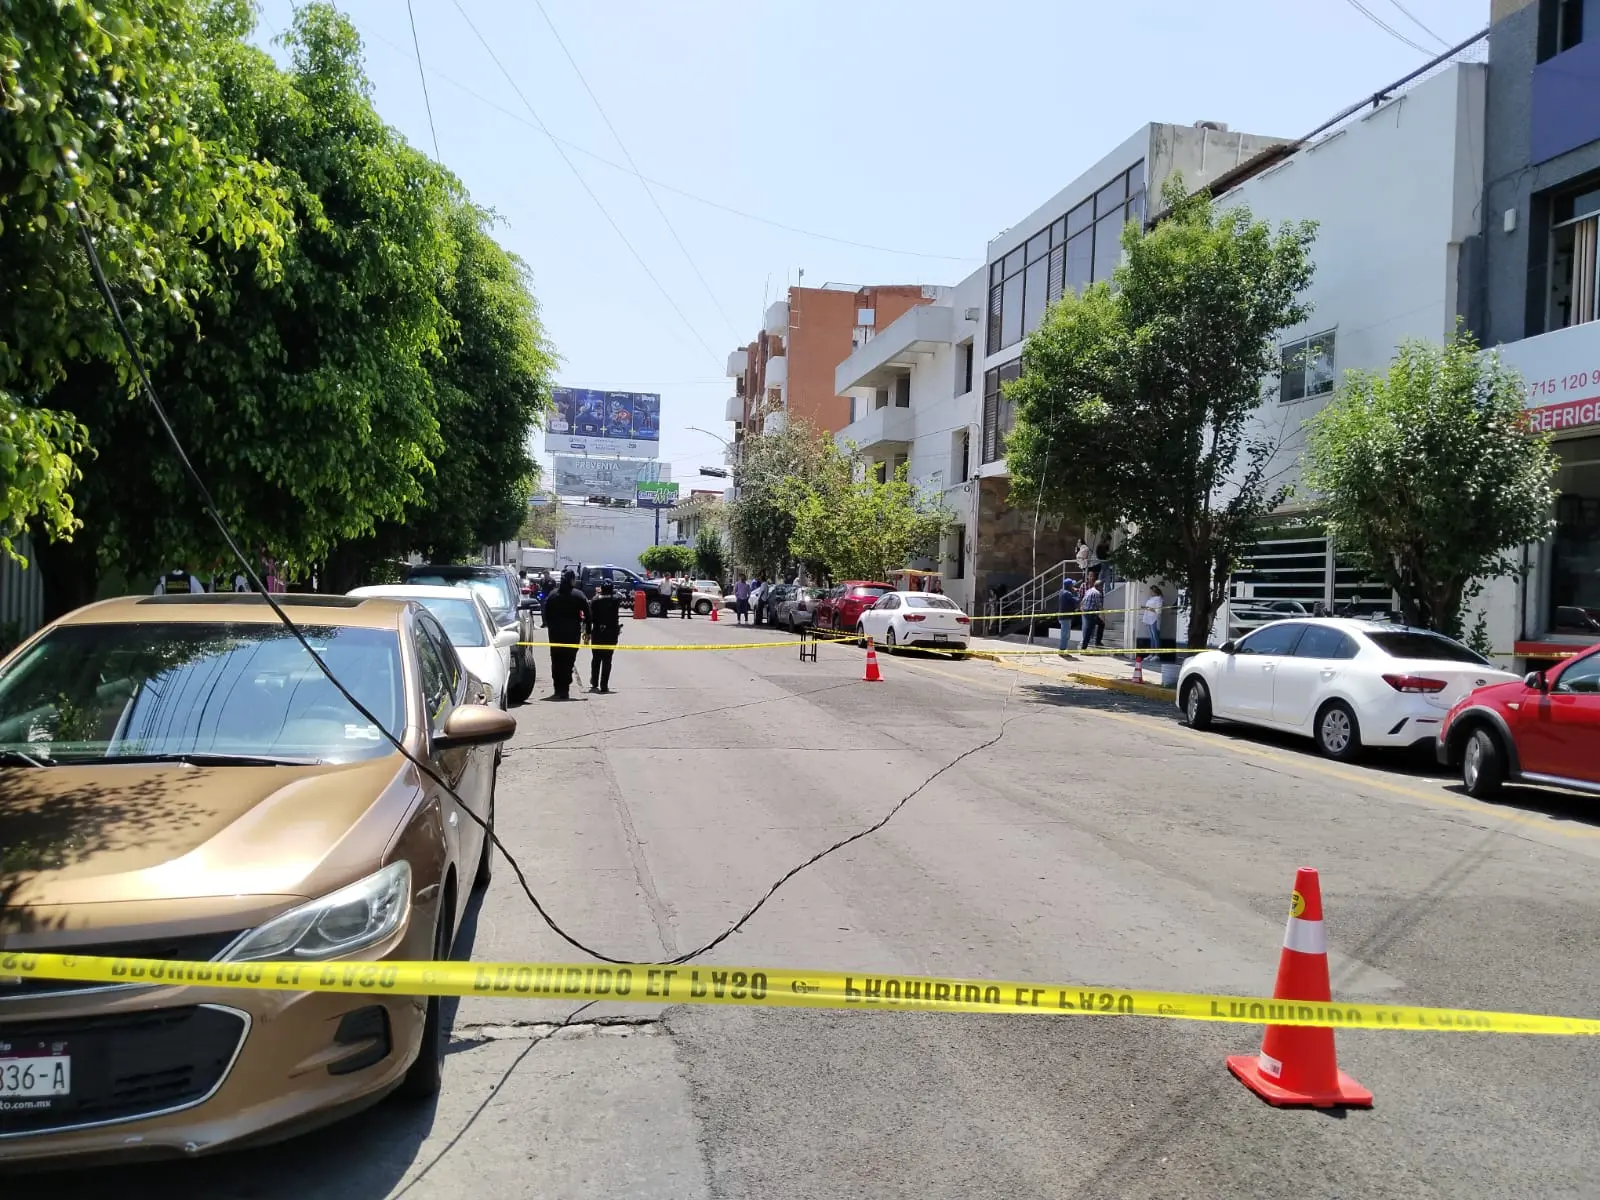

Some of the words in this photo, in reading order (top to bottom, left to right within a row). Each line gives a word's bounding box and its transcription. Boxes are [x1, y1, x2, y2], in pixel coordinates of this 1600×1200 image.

[1531, 379, 1556, 397] 715
[1561, 372, 1587, 391] 120
[575, 461, 620, 471] PREVENTA
[0, 1062, 65, 1091] 36-A
